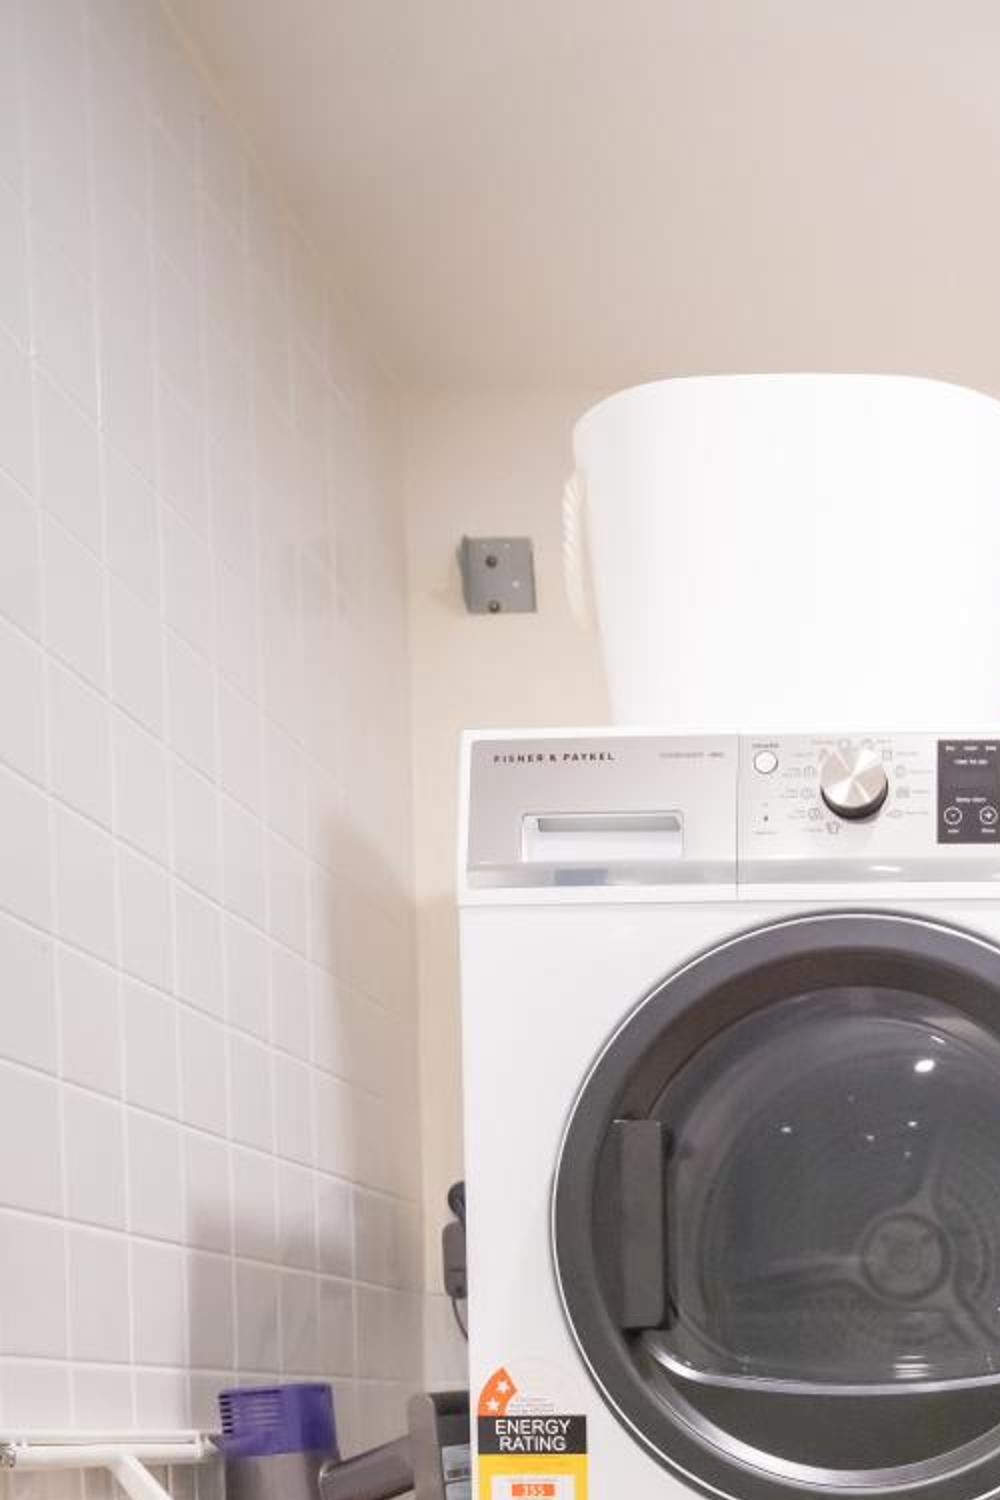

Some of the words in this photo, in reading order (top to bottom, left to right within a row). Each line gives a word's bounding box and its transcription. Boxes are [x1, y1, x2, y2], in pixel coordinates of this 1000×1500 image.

[493, 753, 544, 763] FISHER
[562, 752, 616, 762] PAYKEL
[495, 1419, 570, 1435] ENERGY
[499, 1436, 566, 1451] RATING
